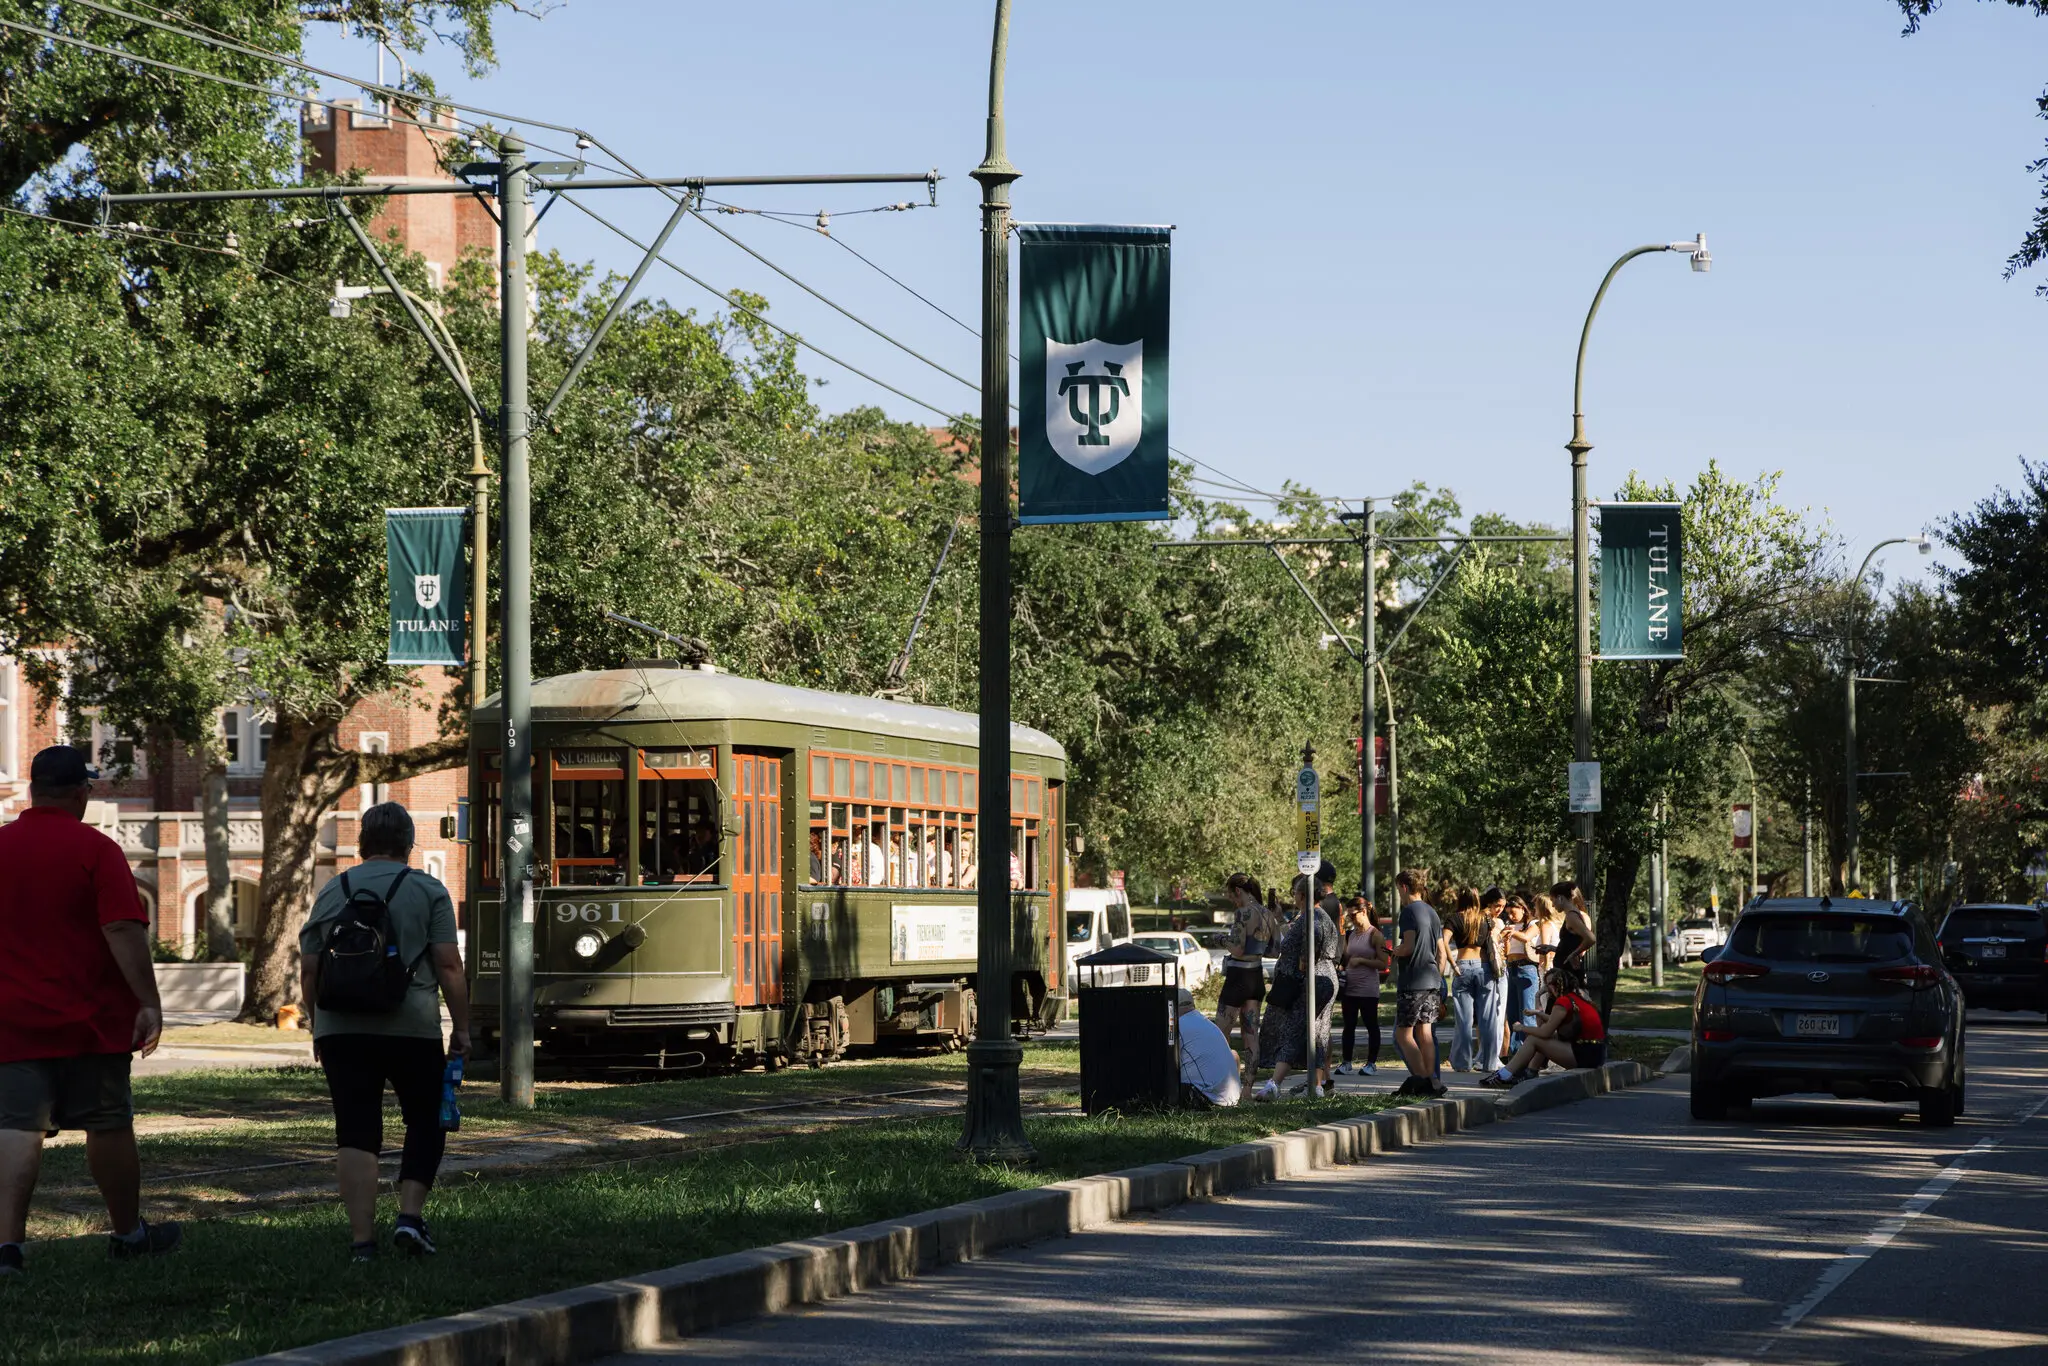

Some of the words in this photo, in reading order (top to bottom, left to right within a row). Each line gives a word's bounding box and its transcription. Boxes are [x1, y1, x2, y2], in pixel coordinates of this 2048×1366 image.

[1648, 524, 1669, 642] TULANE
[396, 619, 460, 632] TULANE
[561, 752, 576, 765] ST.
[577, 750, 623, 764] CHARLES
[556, 902, 624, 923] 961
[811, 922, 829, 941] 961
[1799, 1019, 1816, 1030] 260
[1821, 1019, 1838, 1030] CVX
